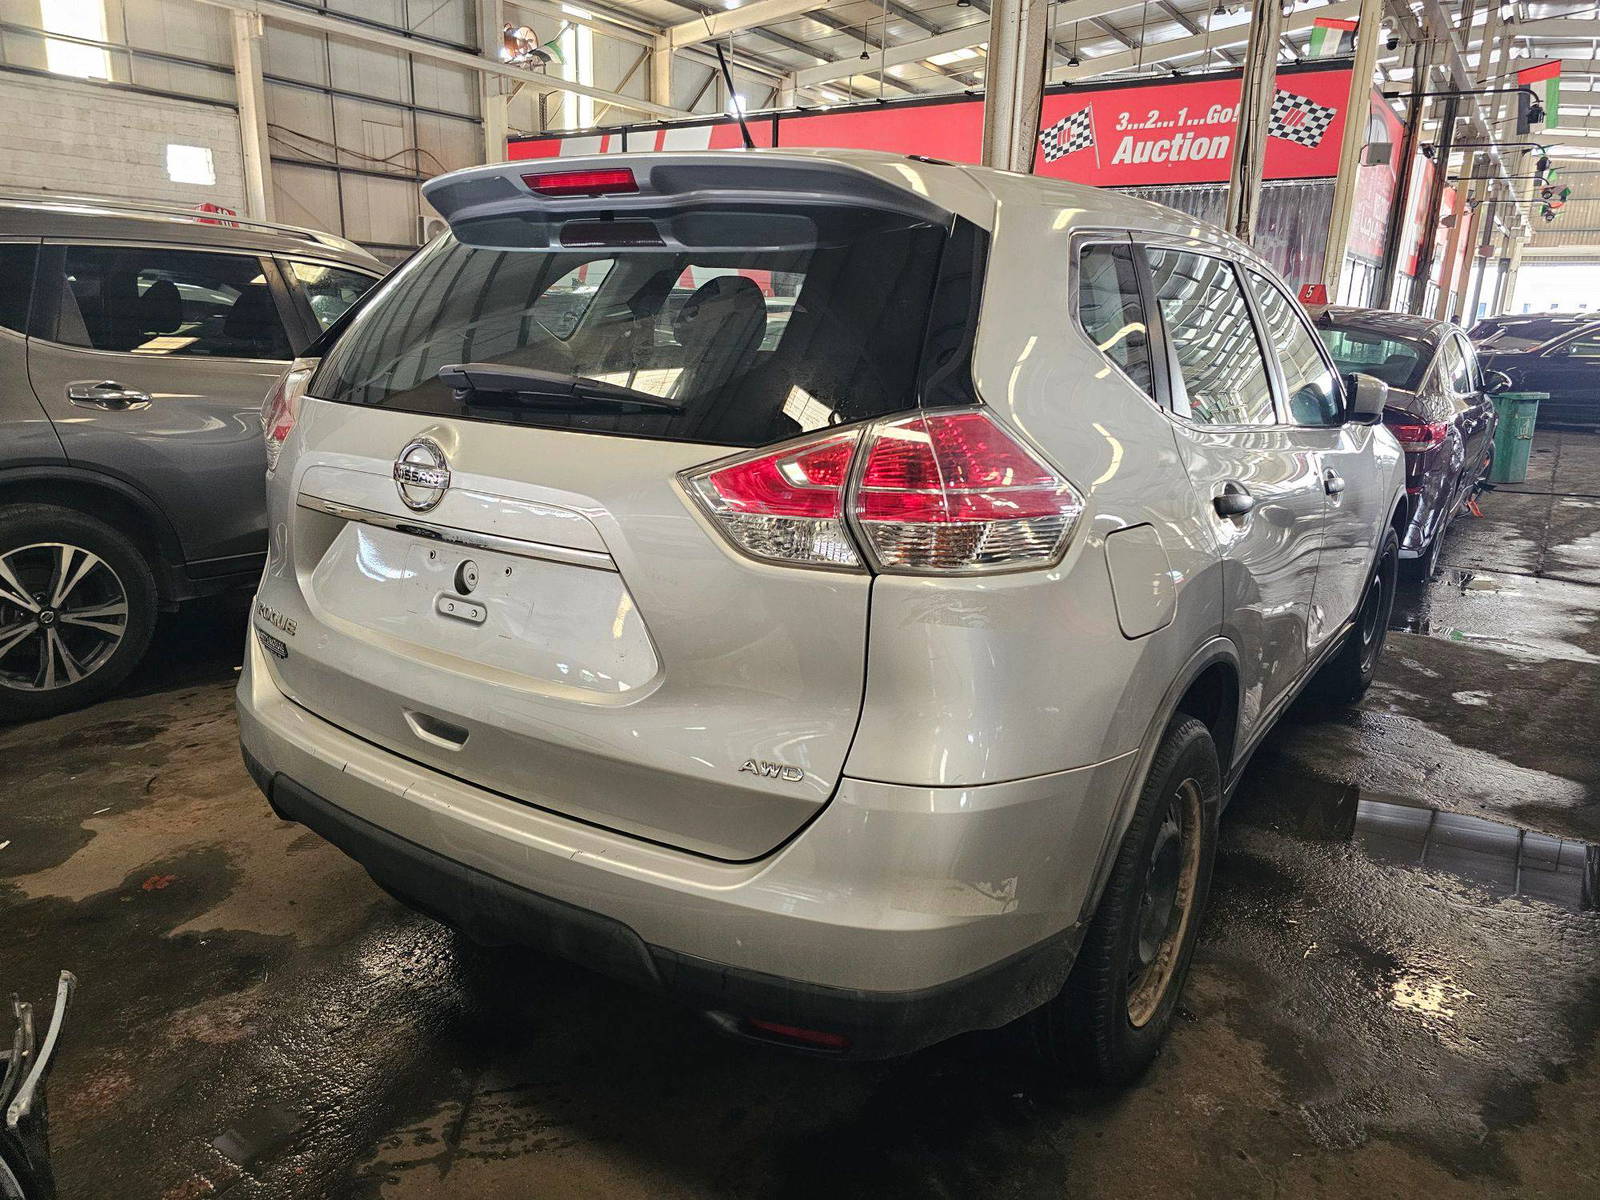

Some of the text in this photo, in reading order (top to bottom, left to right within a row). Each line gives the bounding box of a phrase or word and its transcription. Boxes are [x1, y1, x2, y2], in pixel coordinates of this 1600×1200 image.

[1111, 131, 1231, 165] Auction
[394, 466, 441, 486] NISSAN
[738, 758, 804, 783] AWD
